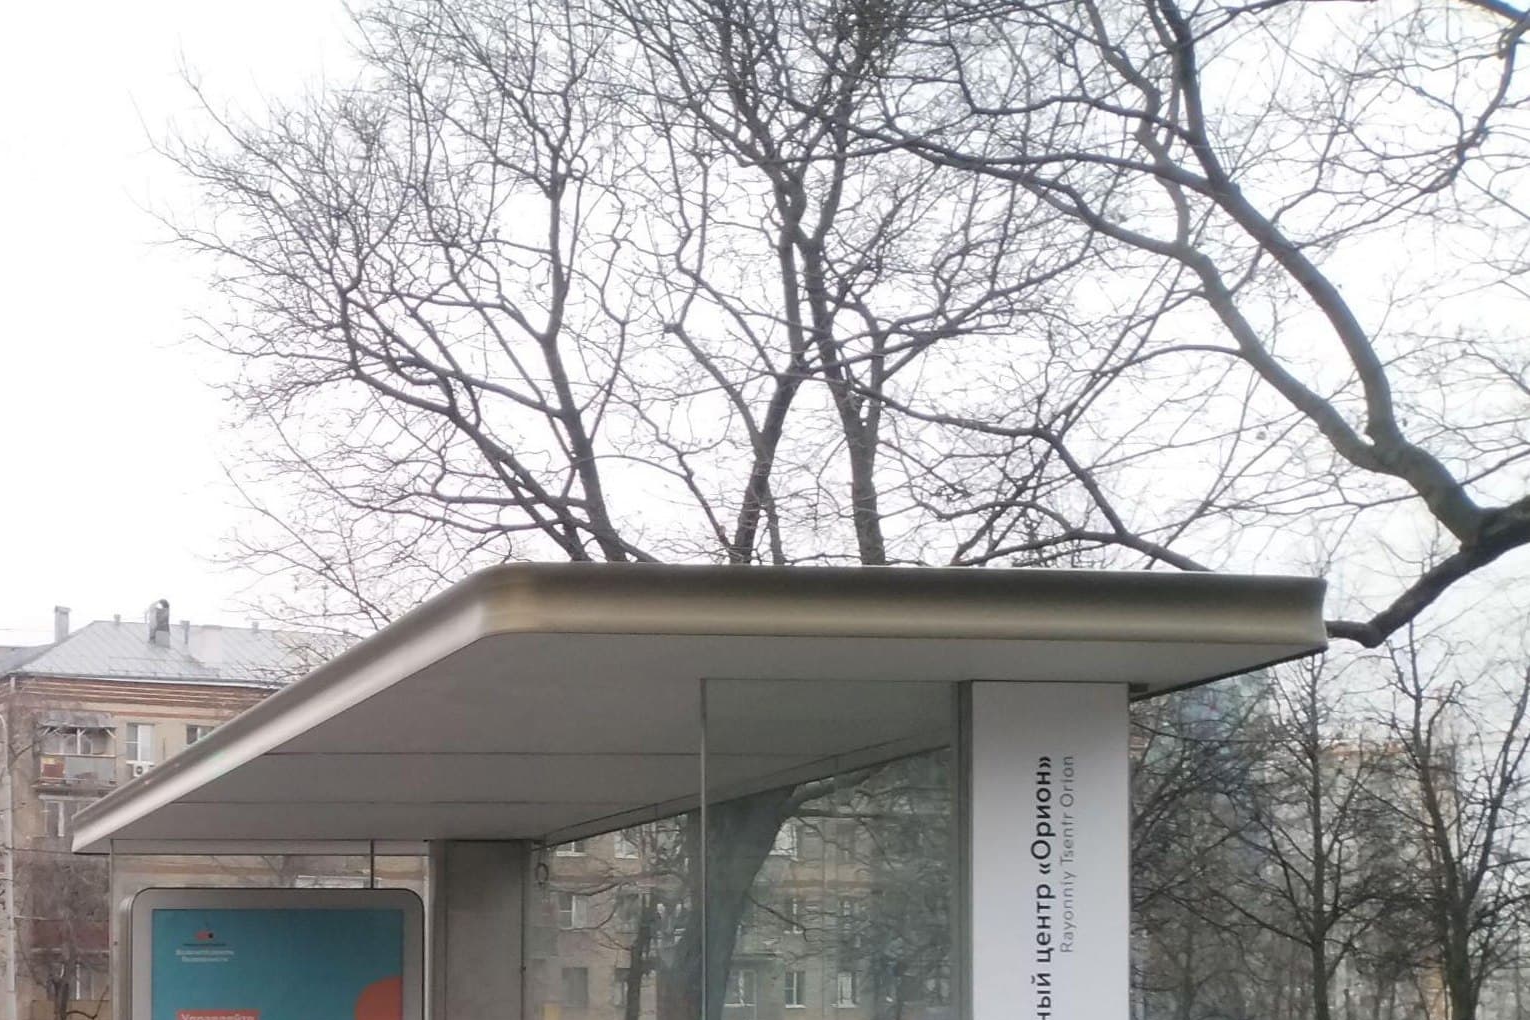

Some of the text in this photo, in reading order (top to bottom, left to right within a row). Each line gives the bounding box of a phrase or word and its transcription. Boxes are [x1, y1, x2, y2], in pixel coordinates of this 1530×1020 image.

[1030, 756, 1056, 875] «Орион»
[1059, 756, 1077, 953] Rayonniy Tsentr Orion
[1035, 883, 1056, 963] центр
